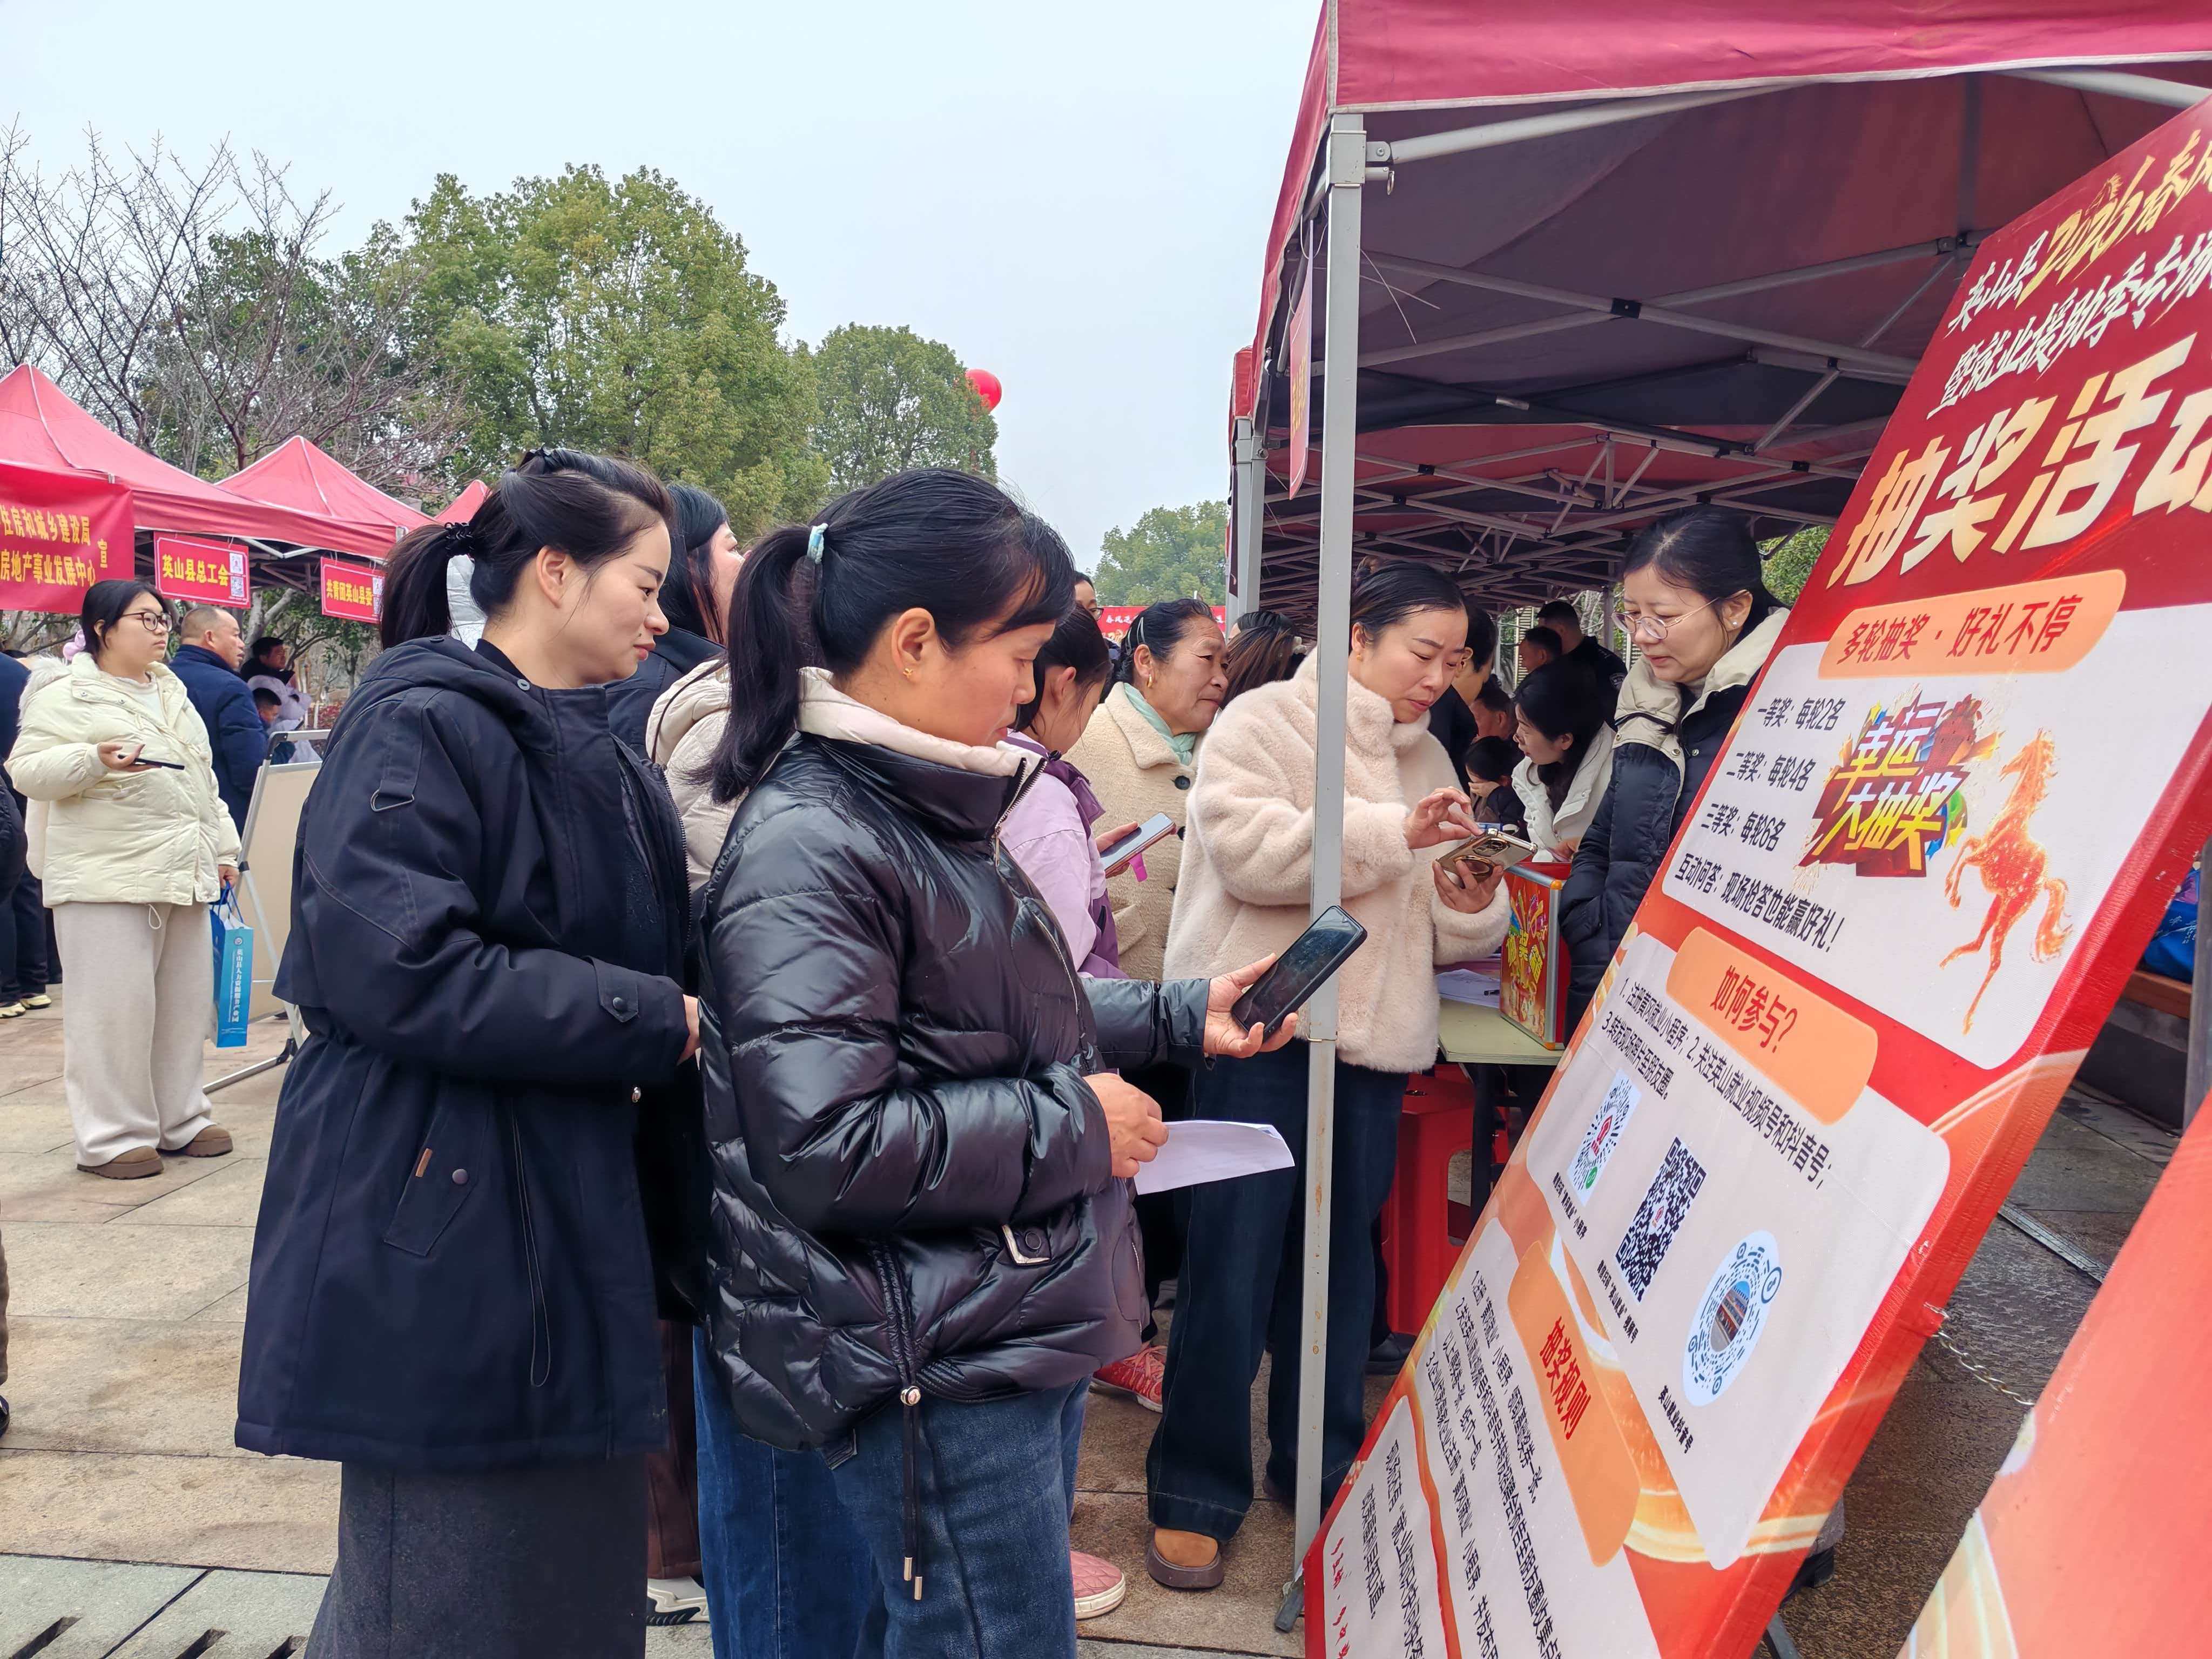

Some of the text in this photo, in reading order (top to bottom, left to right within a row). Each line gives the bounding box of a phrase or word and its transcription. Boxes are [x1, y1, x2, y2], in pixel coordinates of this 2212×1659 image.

[0, 549, 96, 588] 房地产事业发展中心
[162, 554, 228, 586] 英山县总工会
[326, 578, 373, 606] 共青团英山县委
[1757, 697, 1846, 731] 一等奖：每轮2名
[1727, 751, 1817, 792] 二等奖：每轮4名
[1831, 708, 1941, 815] 幸运
[1701, 803, 1786, 852] 三等奖：每轮6名
[1811, 771, 1963, 871] 大抽奖
[1674, 853, 1845, 953] 互动问答：现场抢答也能赢好礼！
[1710, 965, 1798, 1054] 如何参与？
[1539, 1316, 1591, 1440] 抽奖规则
[1658, 1385, 1694, 1454] 英山就业抖音号
[1455, 1297, 1563, 1659] 2.关注英山就业视频号和抖音号并转发招聘会预告至朋友圈收集点
